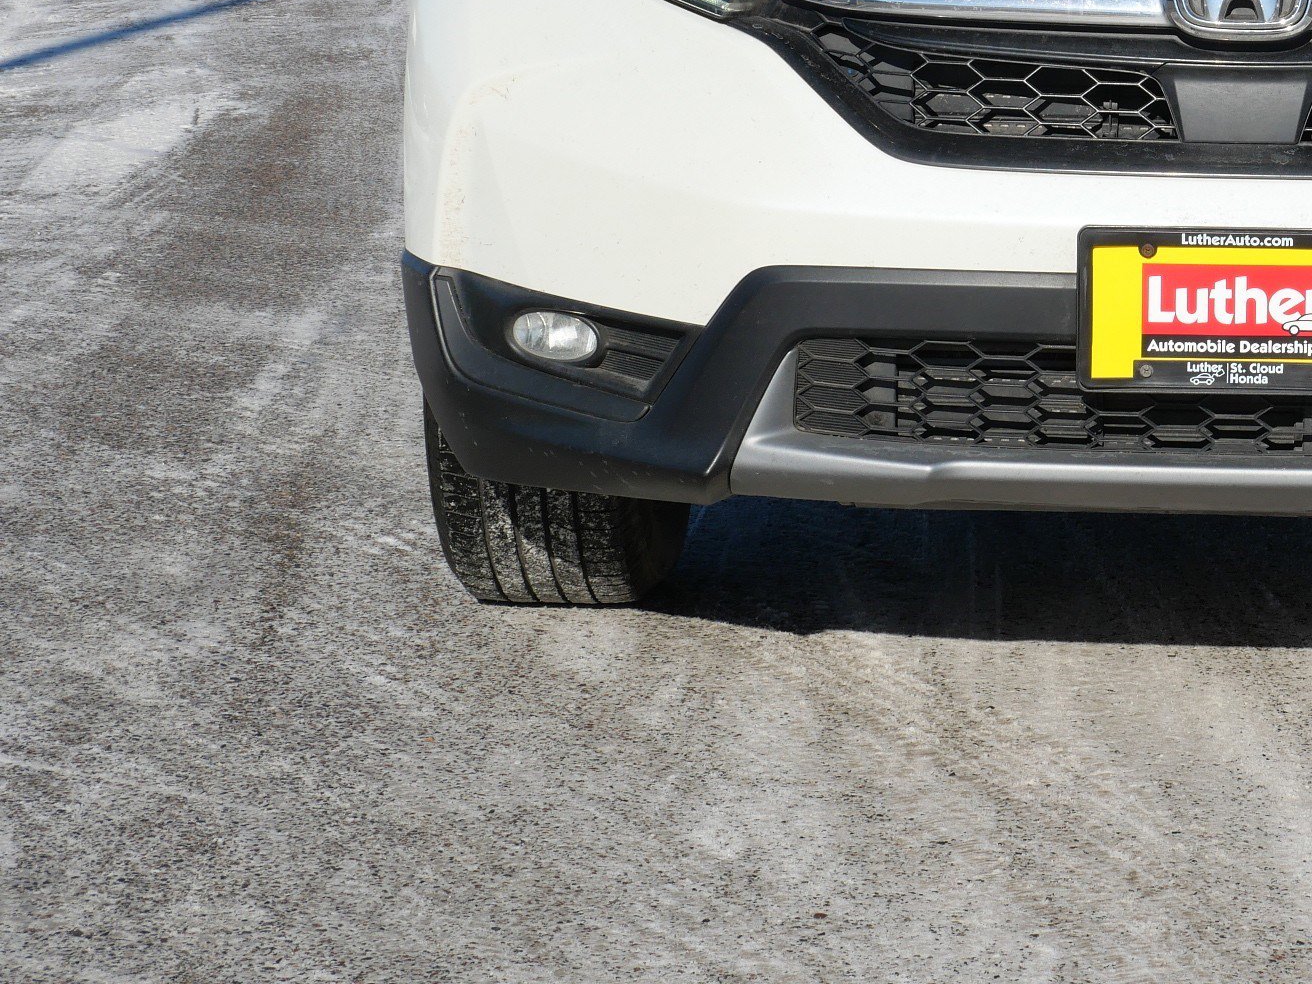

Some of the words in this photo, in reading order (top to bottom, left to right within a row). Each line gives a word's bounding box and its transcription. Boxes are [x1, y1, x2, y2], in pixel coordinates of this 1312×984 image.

[1181, 233, 1294, 247] LutherAuto.com
[1147, 339, 1236, 354] Automobile
[1187, 362, 1223, 373] Luther
[1230, 363, 1246, 374] St.
[1249, 363, 1284, 374] Cloud
[1229, 374, 1269, 385] Honda
